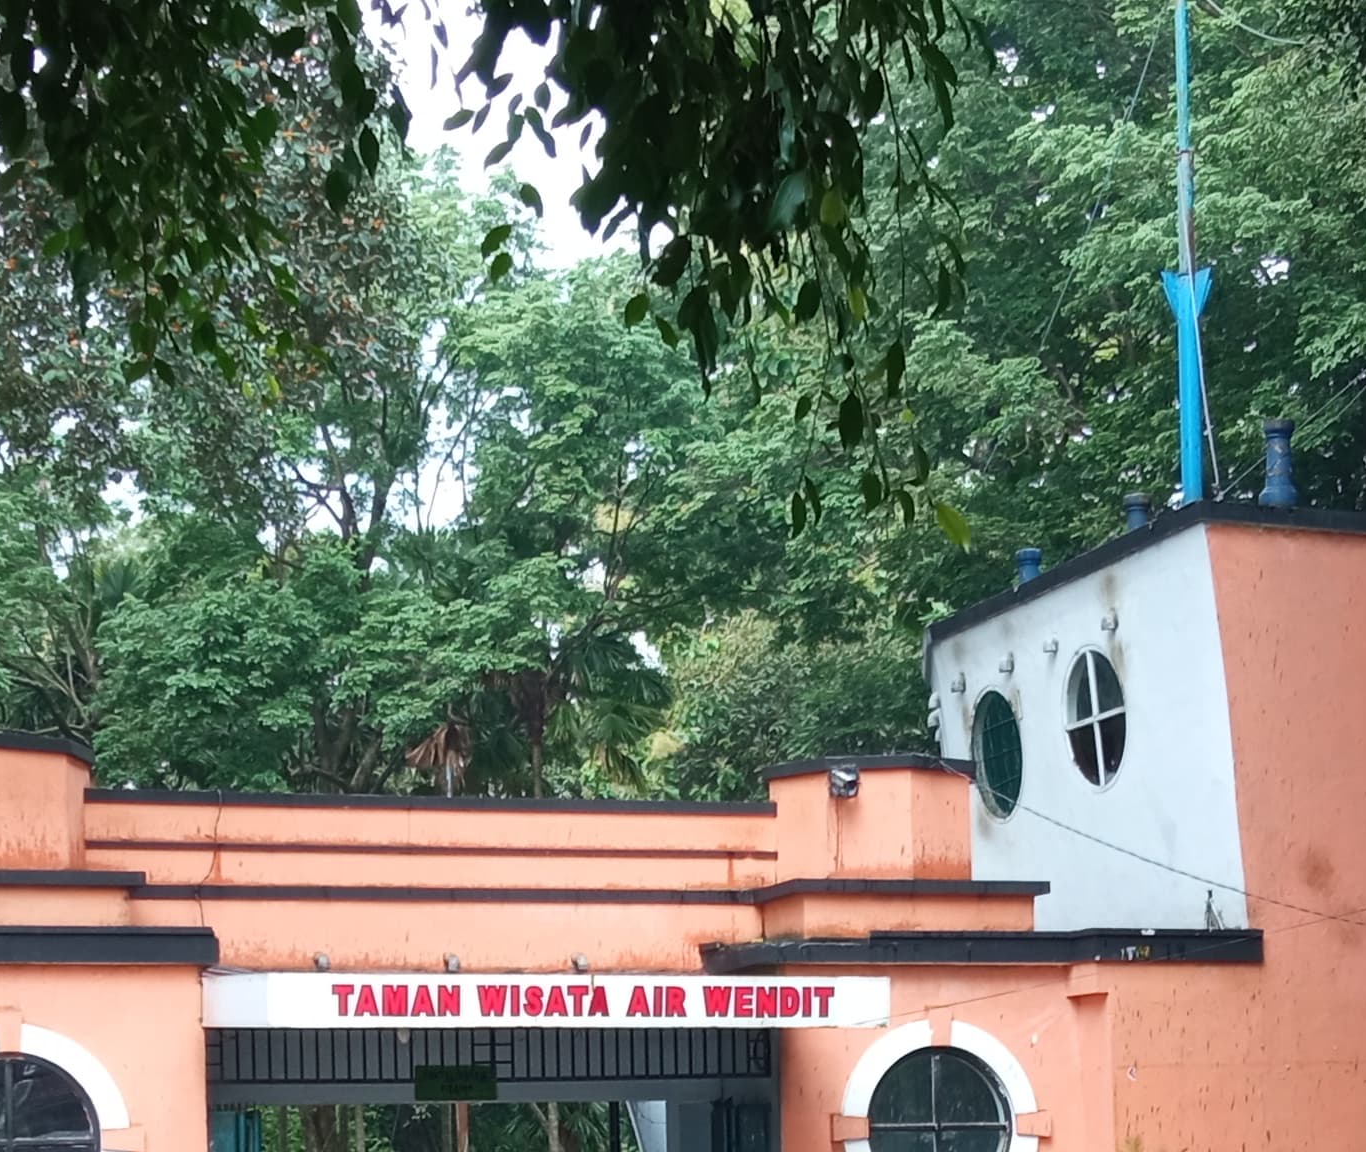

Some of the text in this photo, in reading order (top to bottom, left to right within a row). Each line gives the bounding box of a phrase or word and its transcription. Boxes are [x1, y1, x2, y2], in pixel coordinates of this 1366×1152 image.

[332, 984, 835, 1018] TAMAN WISATA AIR WENDIT
